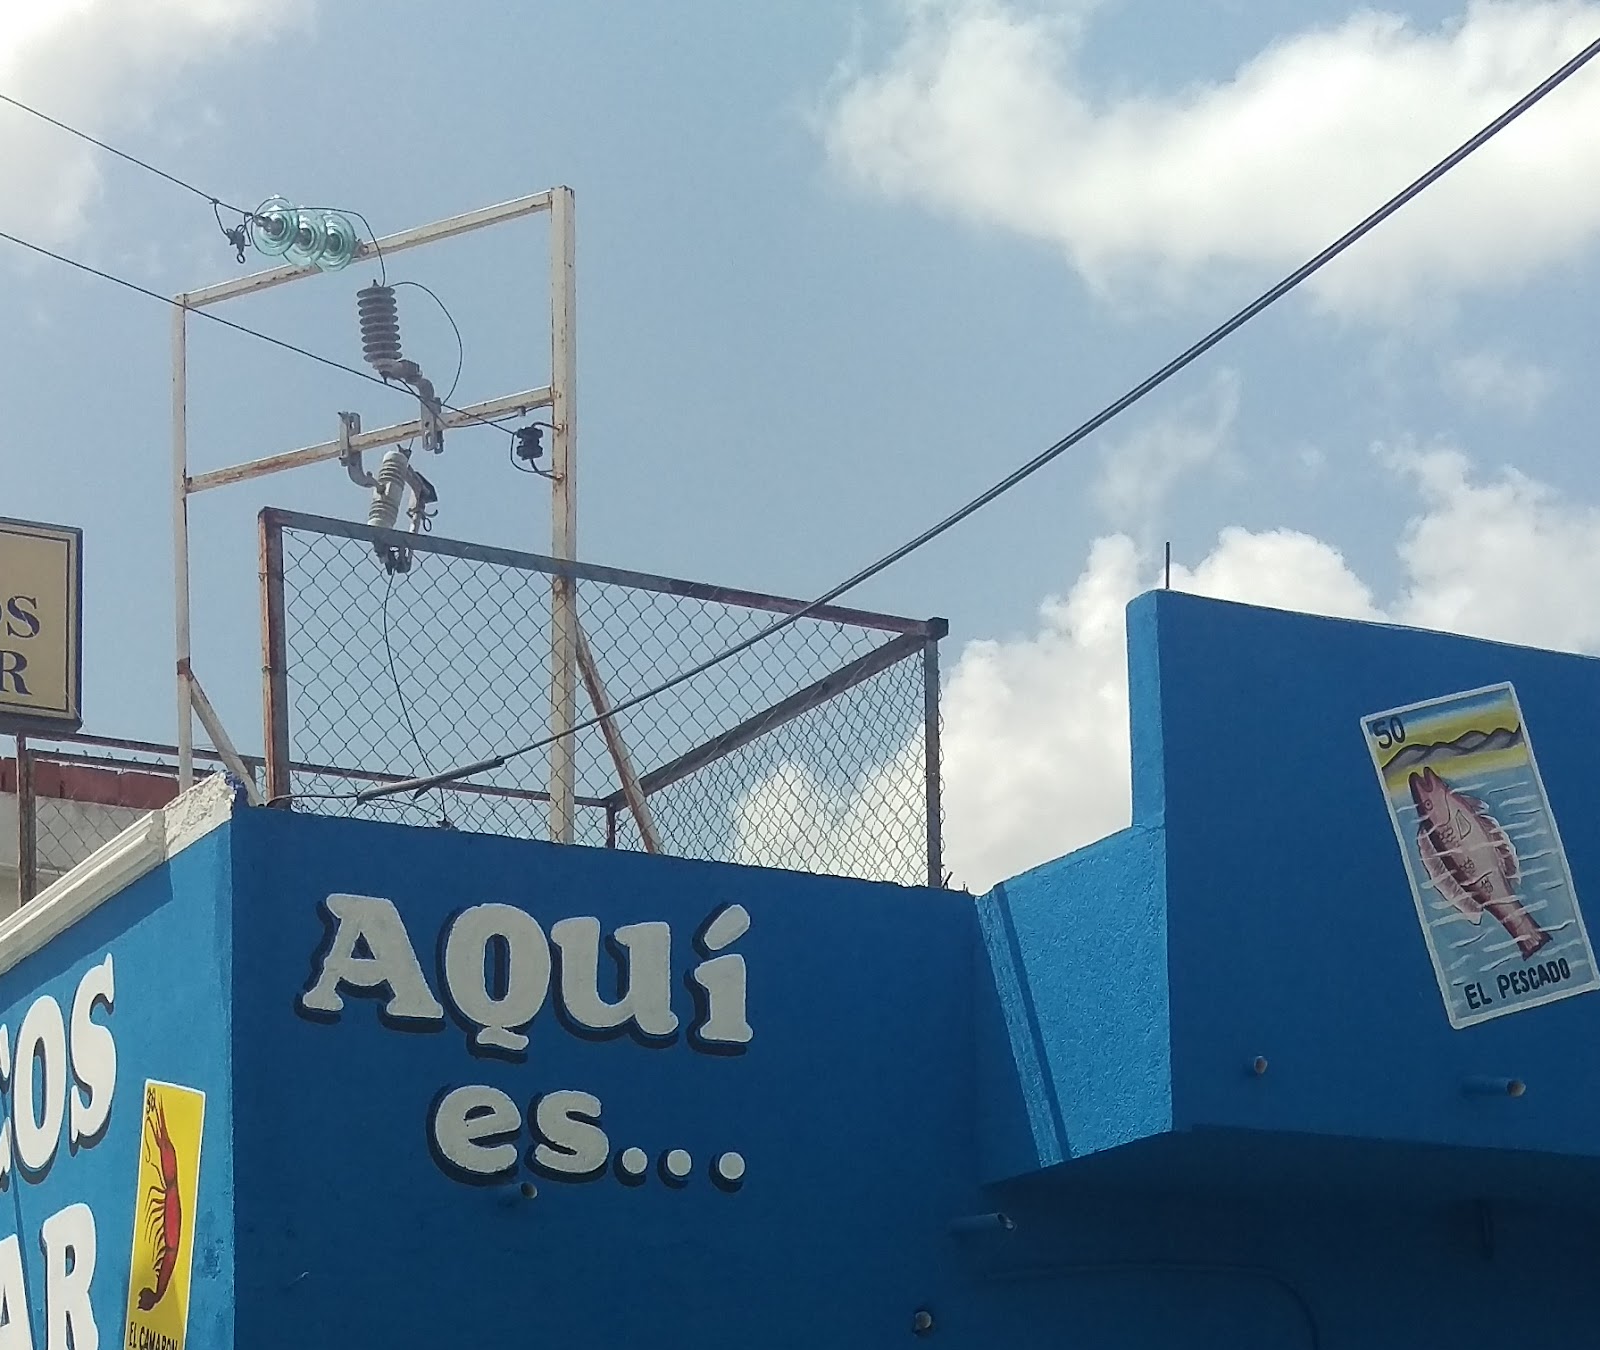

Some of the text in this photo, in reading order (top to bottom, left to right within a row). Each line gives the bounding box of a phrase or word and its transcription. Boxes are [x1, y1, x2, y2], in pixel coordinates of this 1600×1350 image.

[1371, 716, 1406, 750] 50
[1463, 957, 1572, 1010] EL PESCADO
